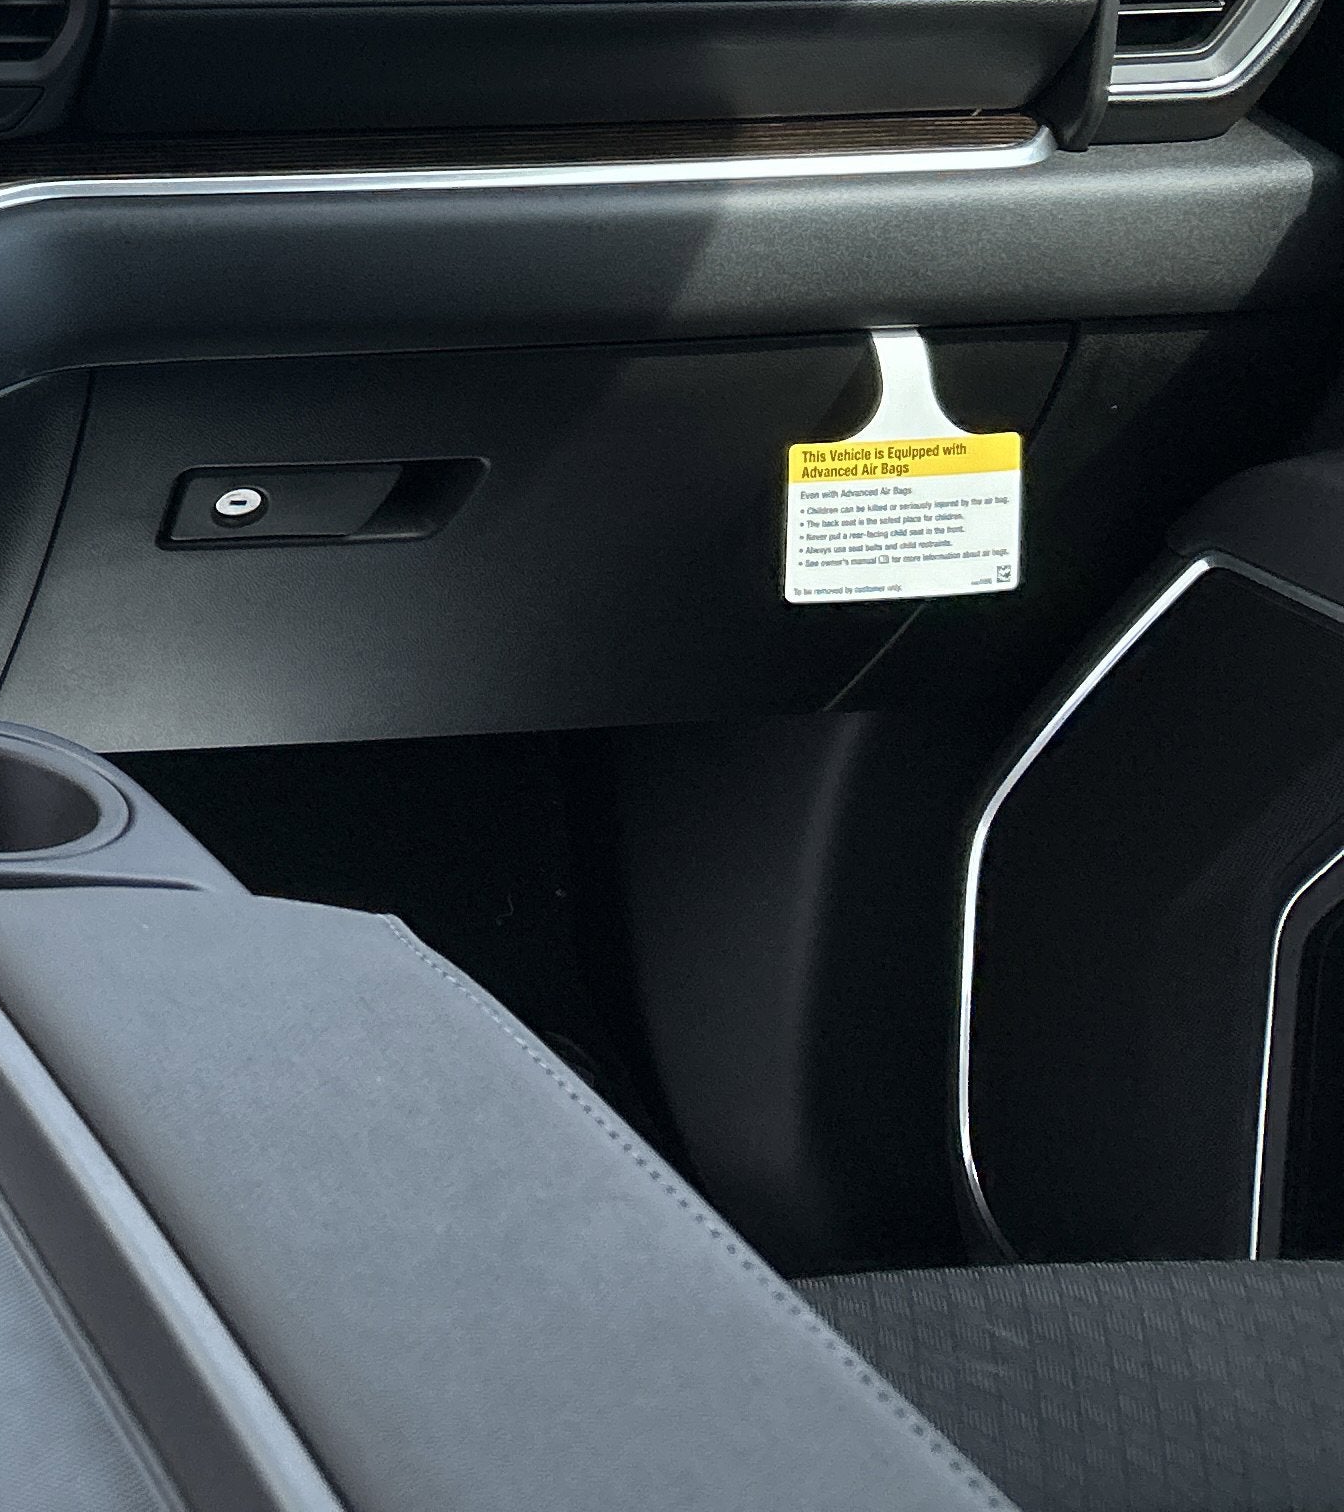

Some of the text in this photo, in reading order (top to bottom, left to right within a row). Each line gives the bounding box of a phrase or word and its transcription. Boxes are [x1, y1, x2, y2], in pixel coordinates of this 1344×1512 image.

[802, 443, 967, 463] This Vehicle is Equipped with
[801, 461, 910, 479] Advanced Air Bags
